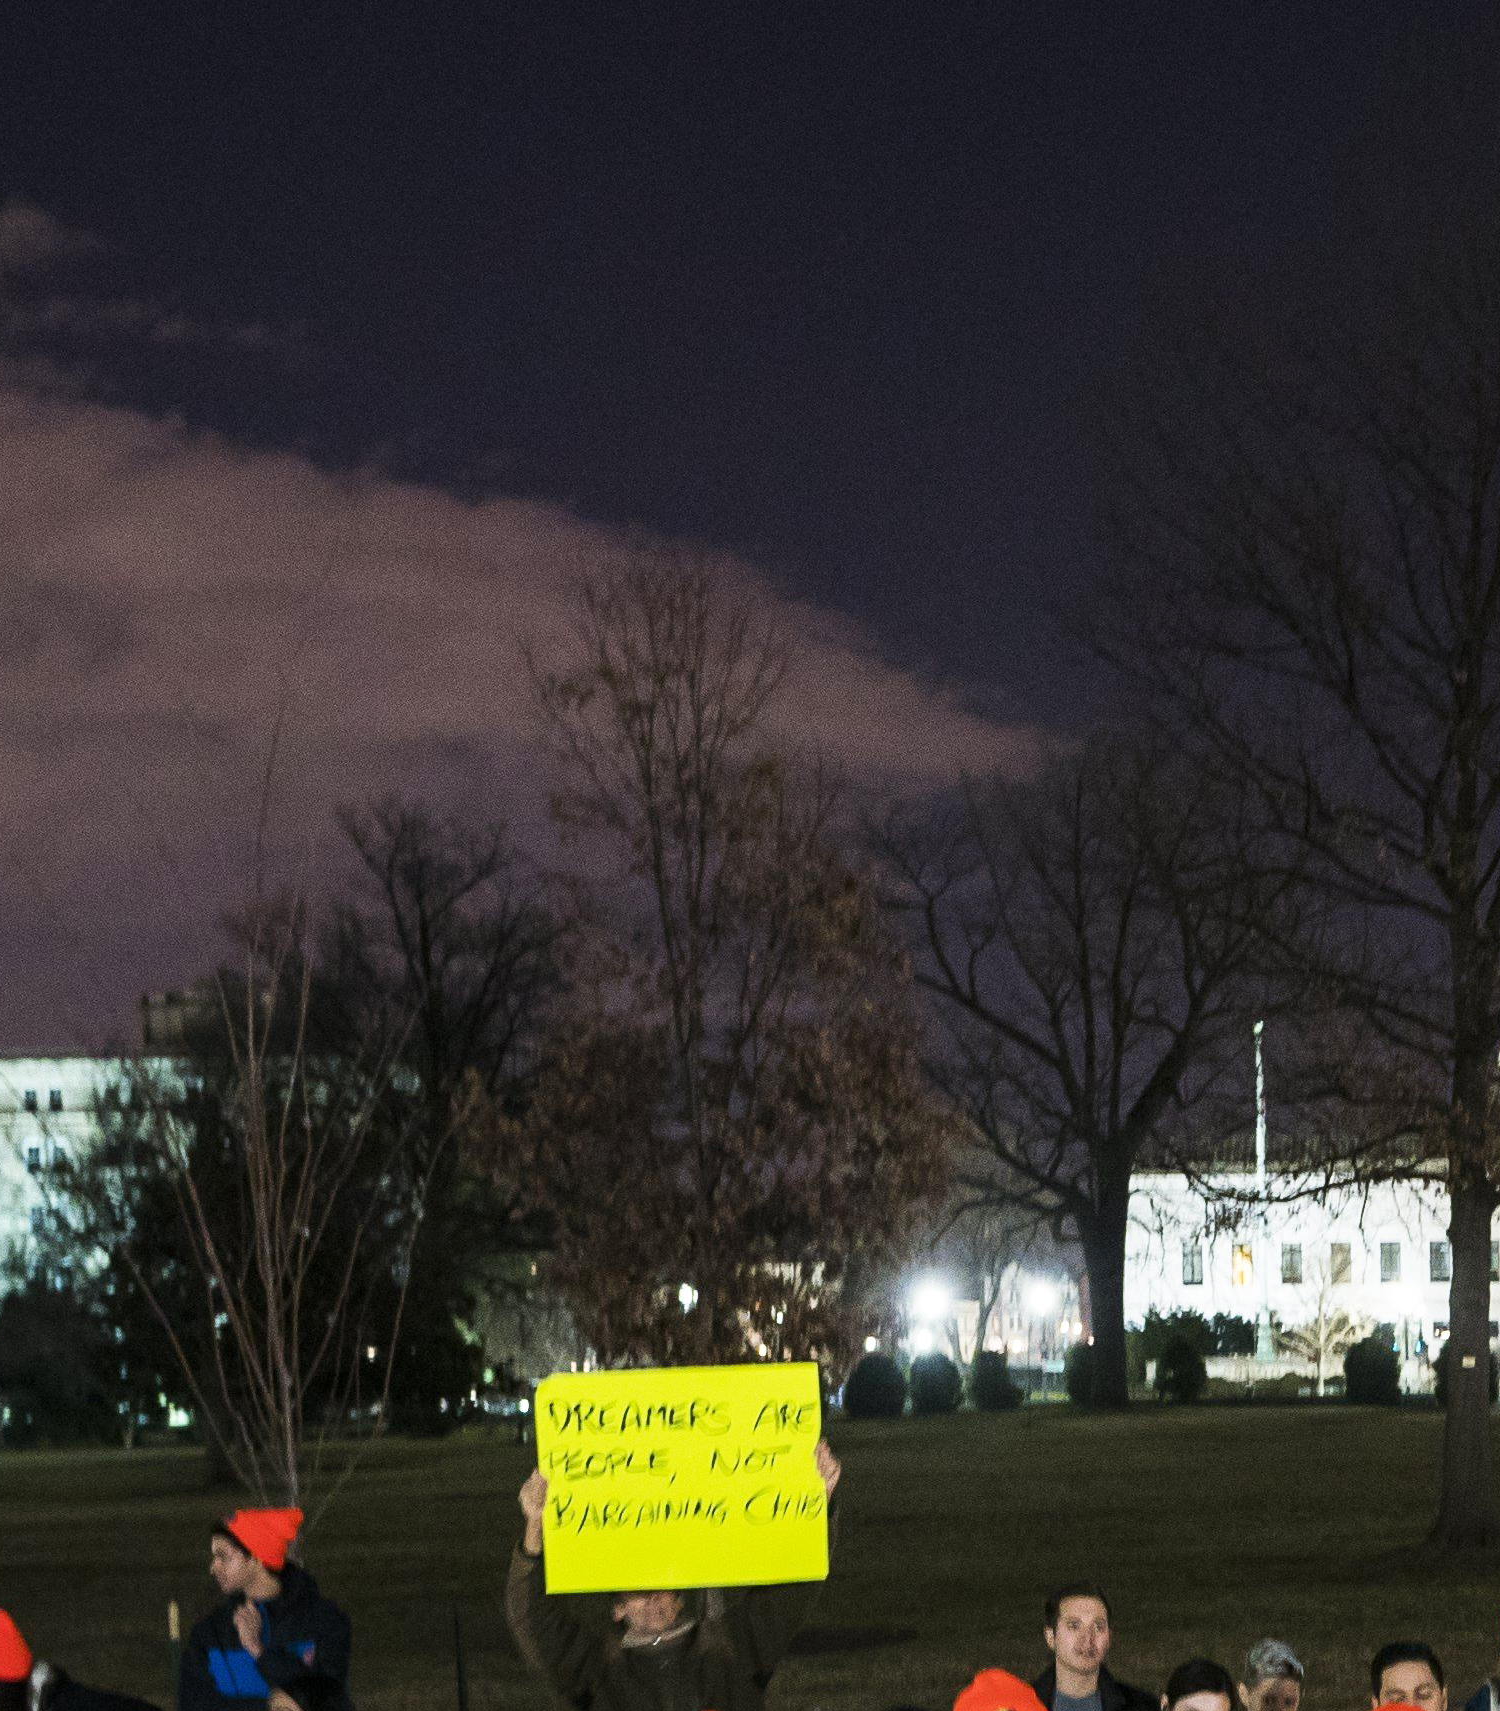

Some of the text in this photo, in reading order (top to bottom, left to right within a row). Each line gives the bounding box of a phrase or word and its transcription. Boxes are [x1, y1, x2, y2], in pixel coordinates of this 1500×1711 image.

[547, 1397, 817, 1436] DREAMERS ARE
[544, 1444, 792, 1487] PEOPLE, NOT
[550, 1492, 728, 1535] BARGAINING
